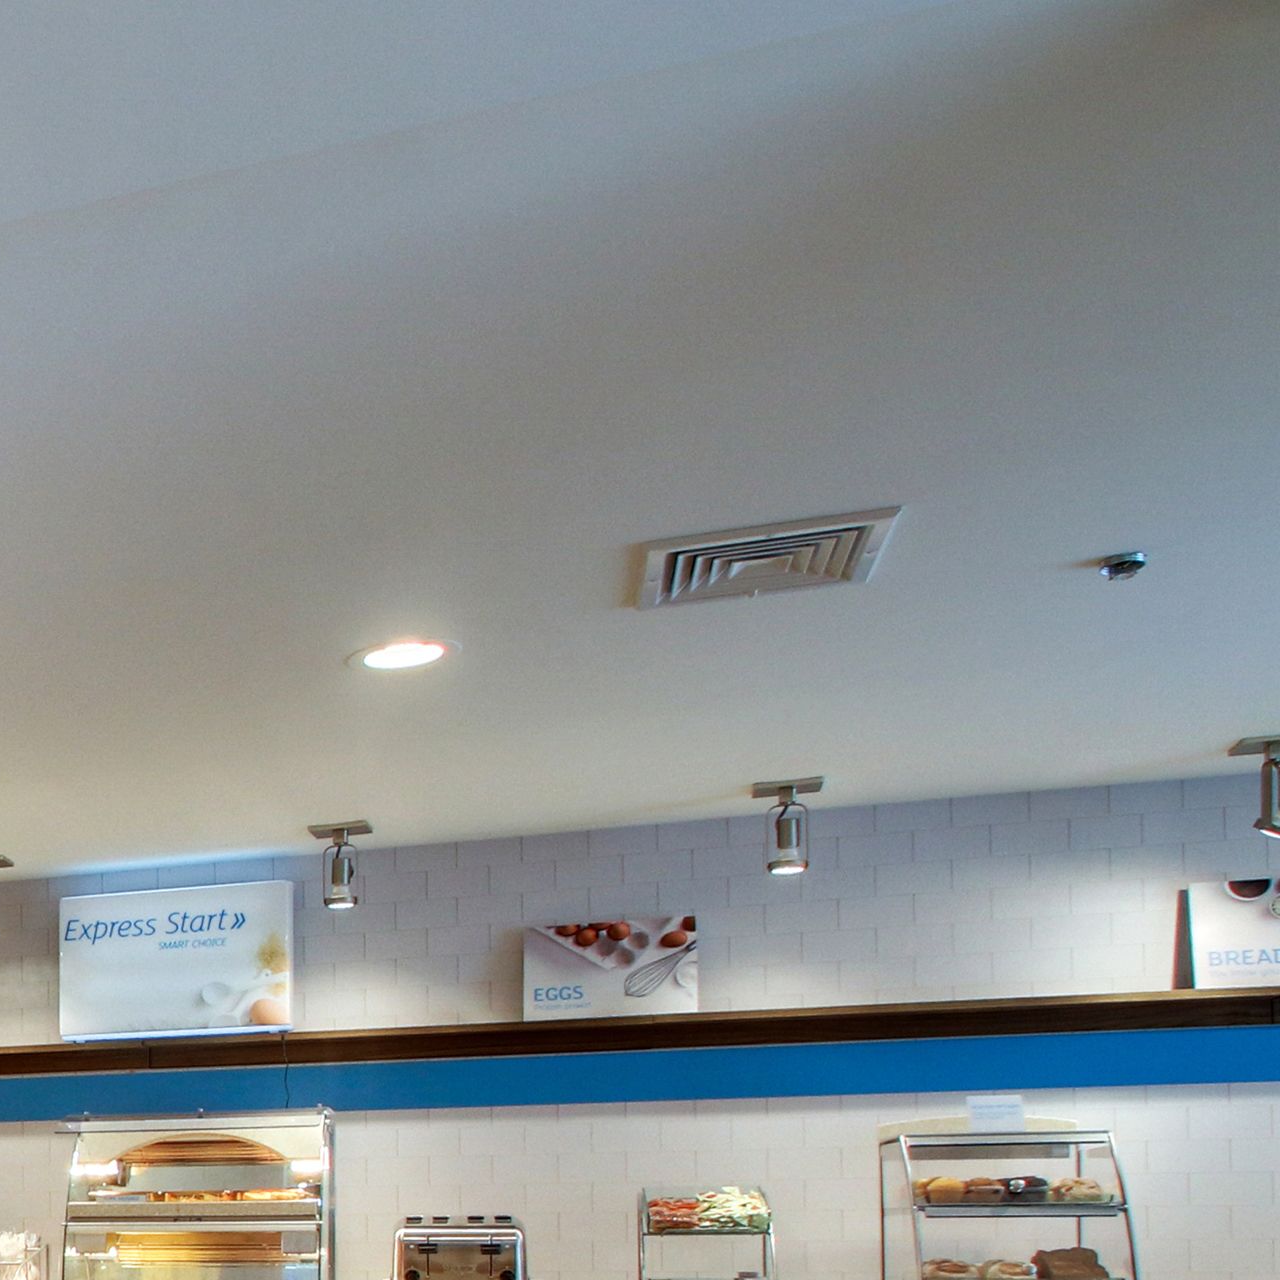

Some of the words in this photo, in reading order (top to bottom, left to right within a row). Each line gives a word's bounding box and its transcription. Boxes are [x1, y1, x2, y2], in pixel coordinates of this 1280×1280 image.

[64, 917, 157, 945] Express
[158, 939, 190, 950] SMART
[192, 937, 227, 948] CHOICE
[534, 985, 584, 1002] EGGS
